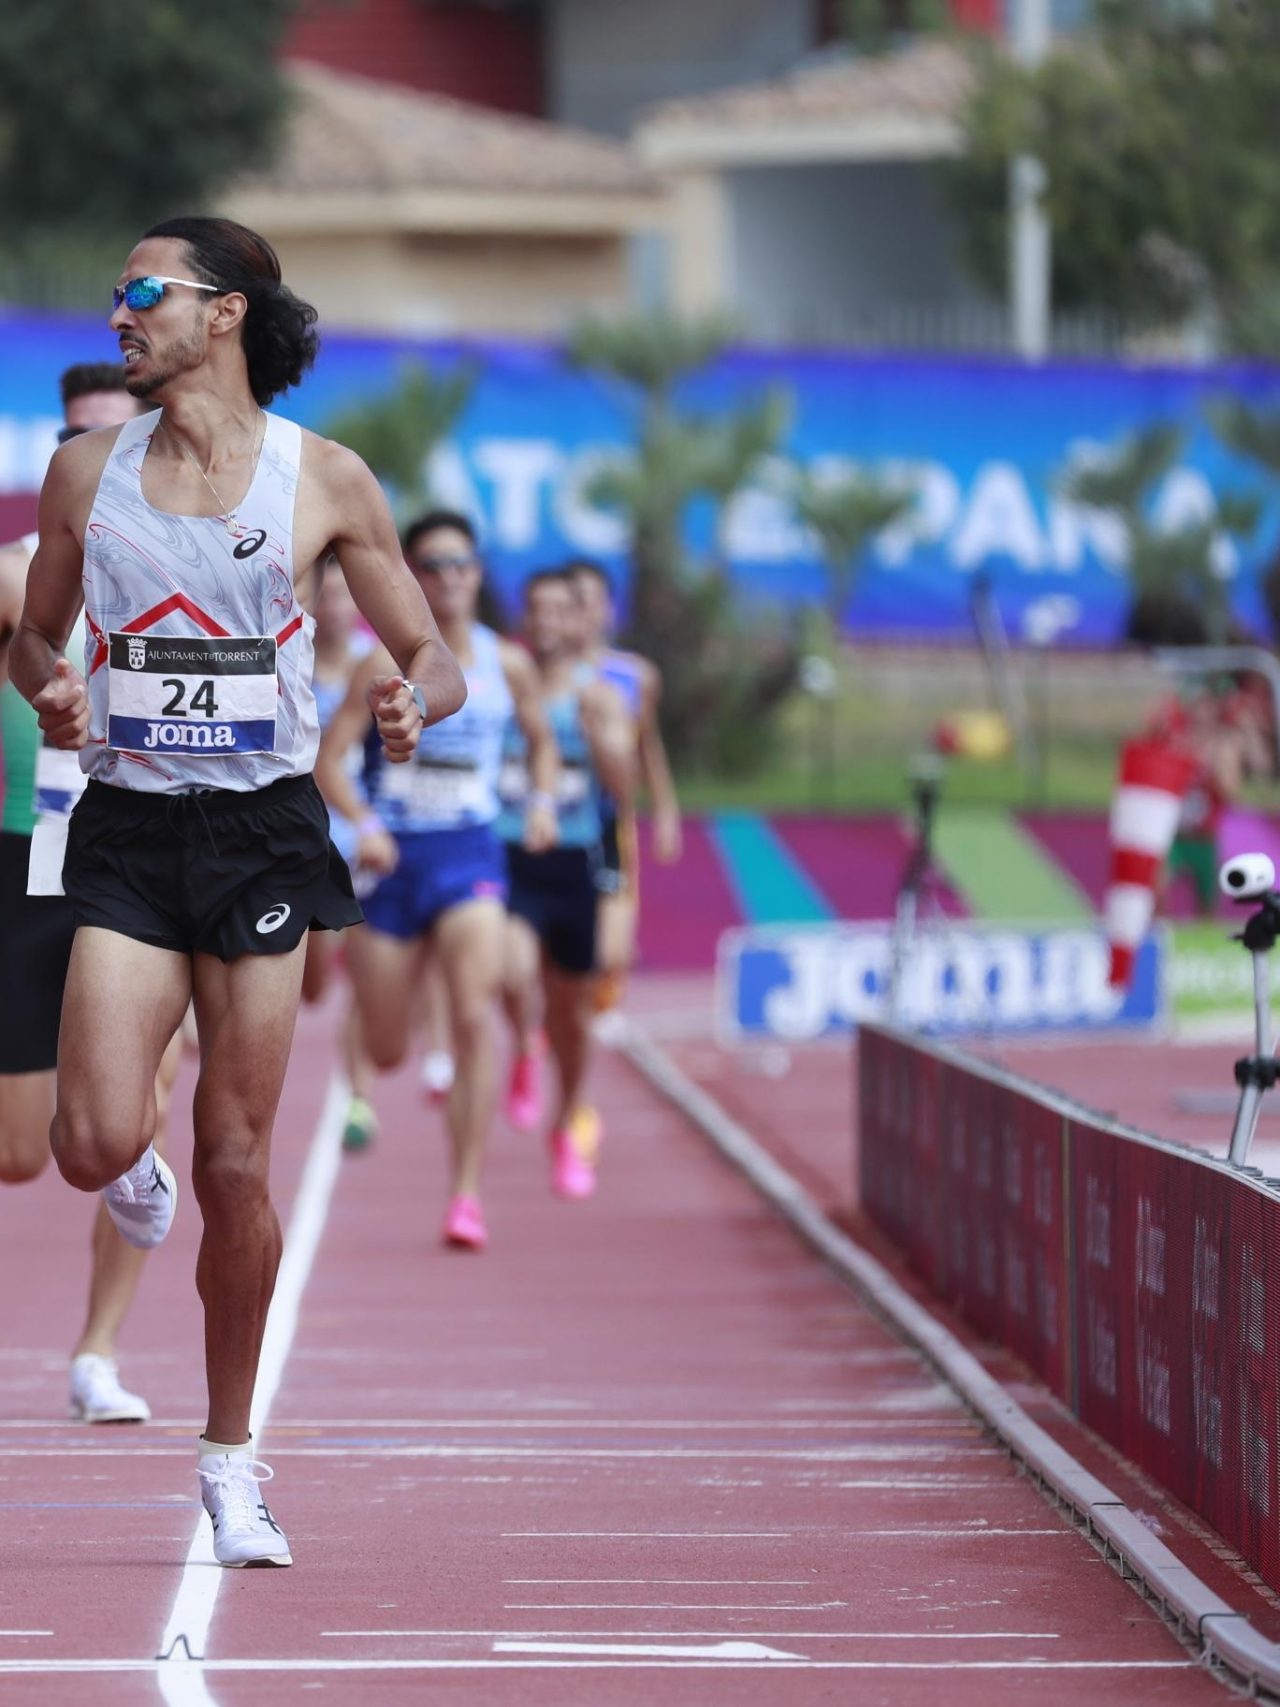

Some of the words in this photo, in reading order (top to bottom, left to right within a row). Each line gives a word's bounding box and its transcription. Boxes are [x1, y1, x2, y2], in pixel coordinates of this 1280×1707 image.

[214, 650, 260, 662] TORRENT
[161, 678, 219, 718] 24
[143, 722, 237, 748] Joma
